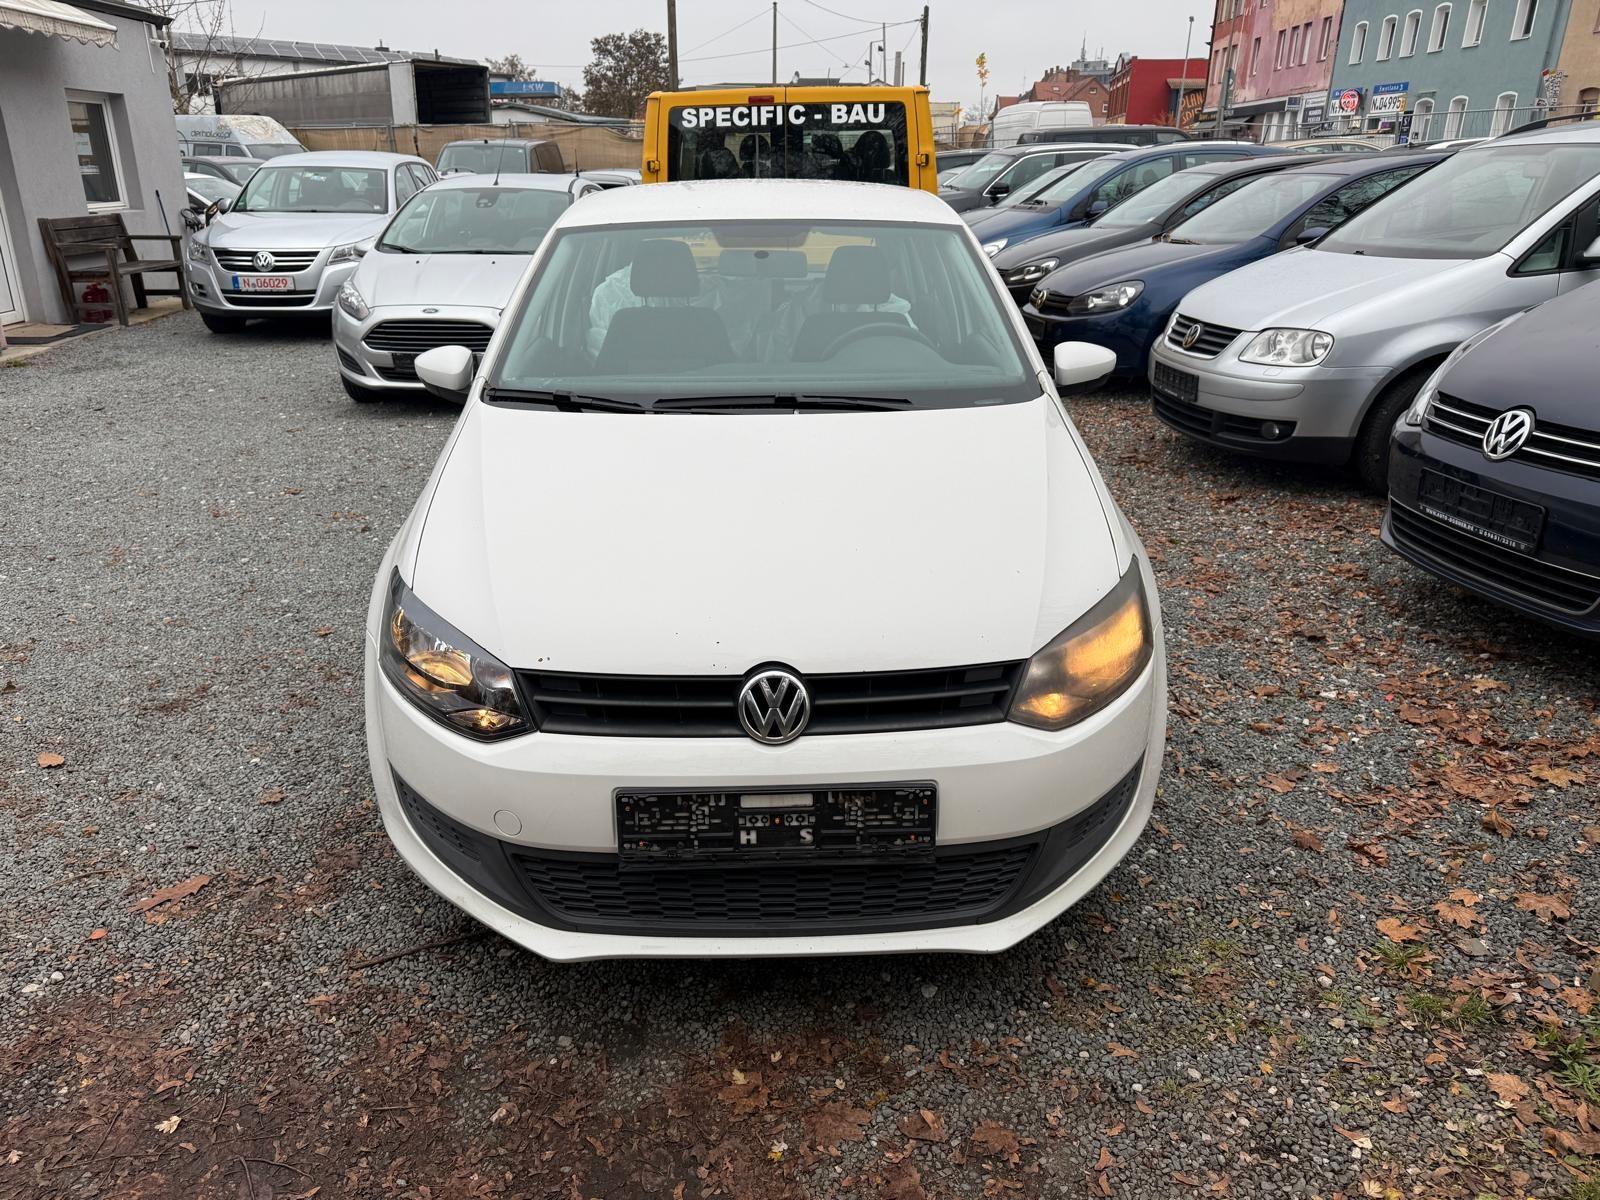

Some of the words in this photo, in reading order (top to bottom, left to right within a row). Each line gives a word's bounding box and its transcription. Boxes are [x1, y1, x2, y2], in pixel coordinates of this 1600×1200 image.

[681, 105, 806, 128] SPECIFIC
[831, 104, 886, 124] BAU
[255, 278, 288, 288] 06029
[1484, 410, 1530, 459] VW
[740, 672, 809, 742] VW
